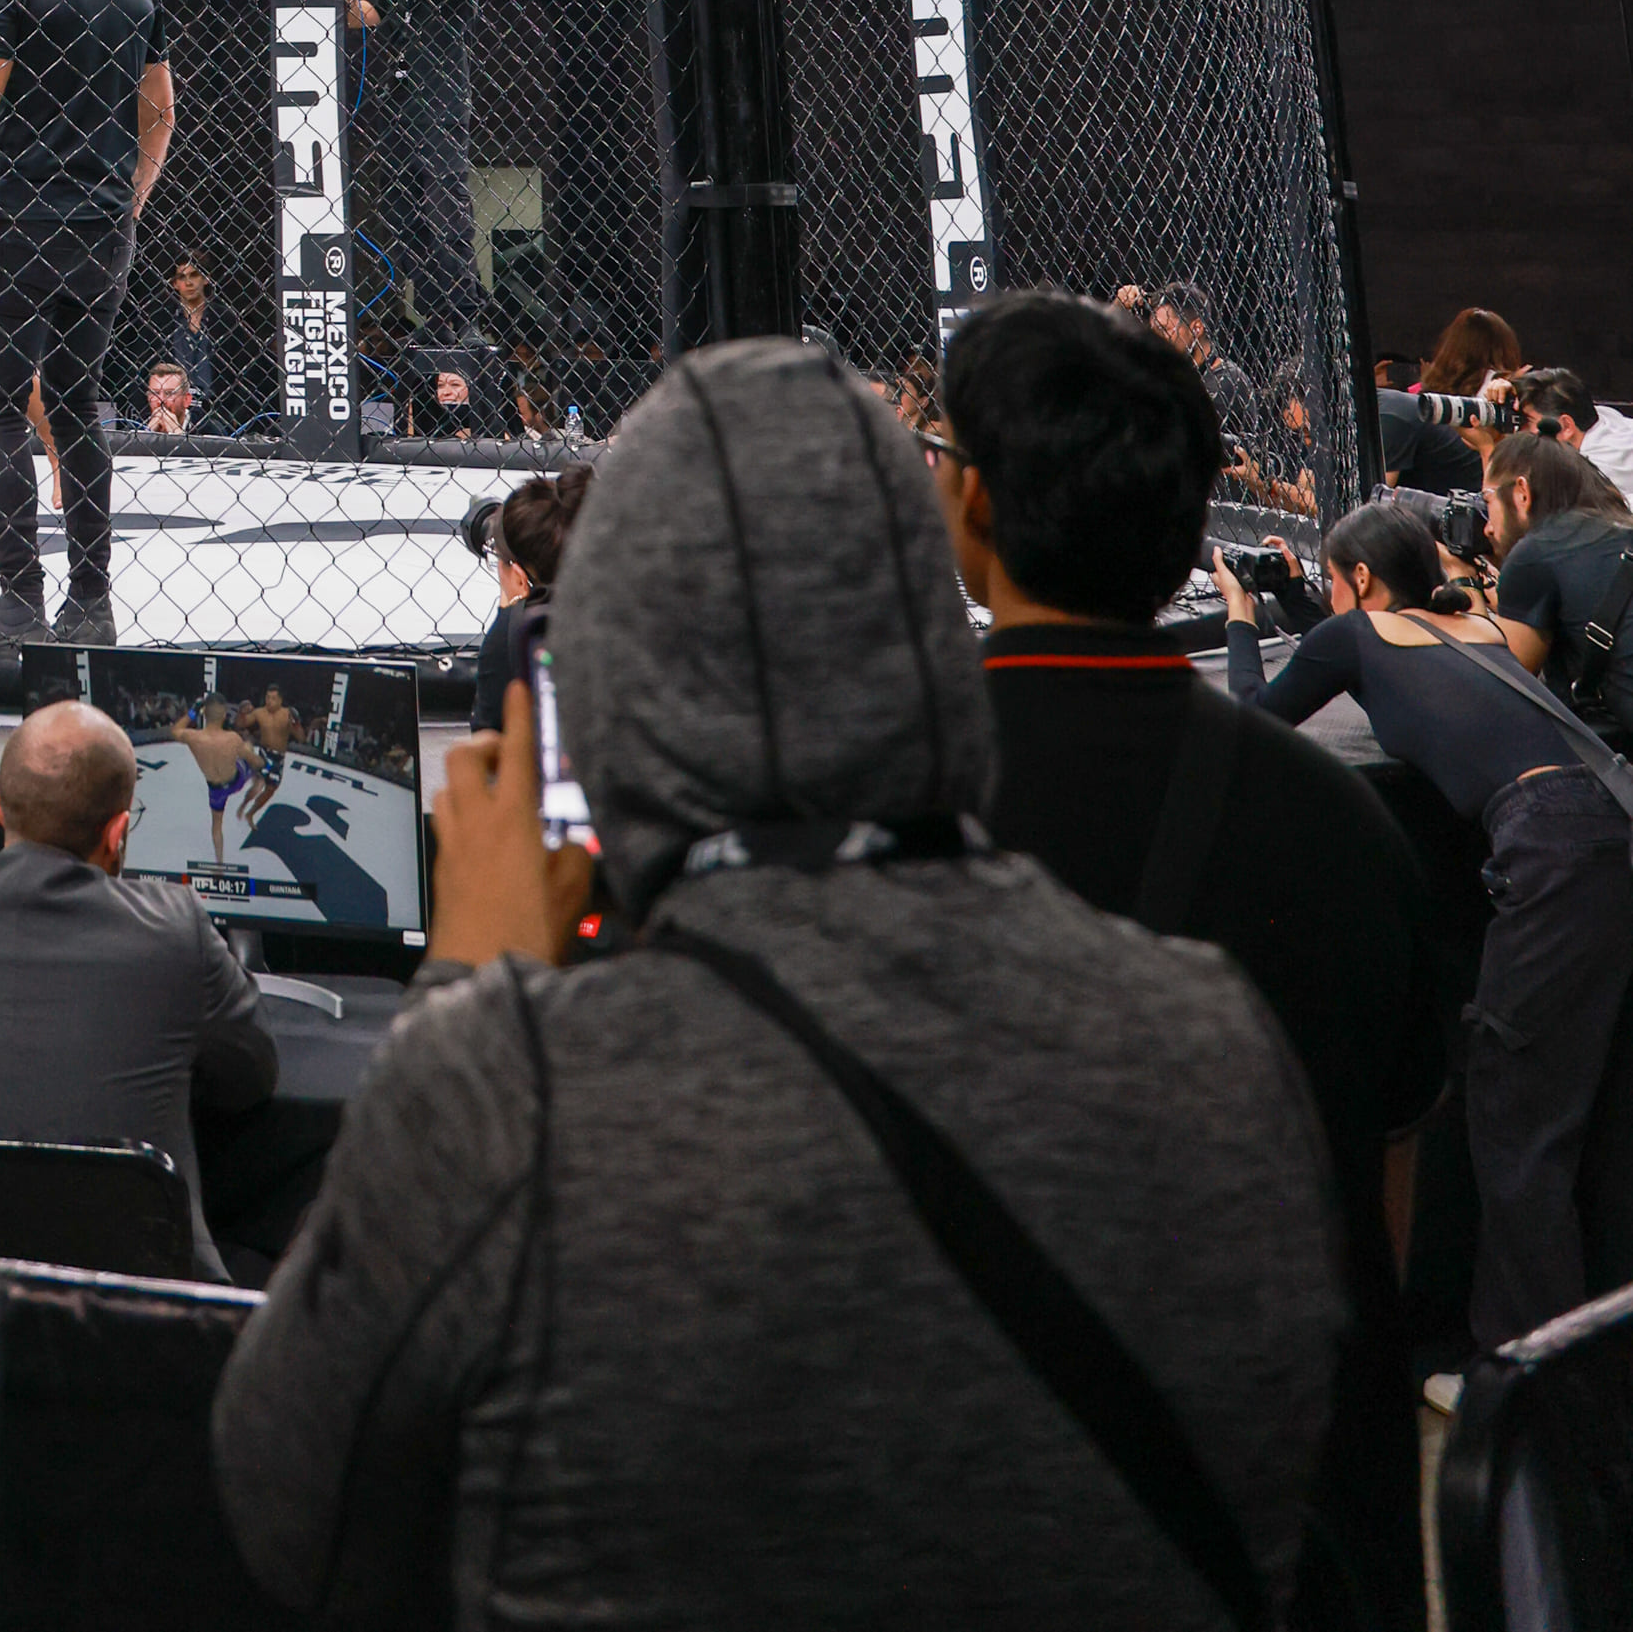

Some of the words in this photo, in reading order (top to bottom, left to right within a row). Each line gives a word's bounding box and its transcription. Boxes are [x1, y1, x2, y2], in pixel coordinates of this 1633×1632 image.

[274, 6, 346, 277] MFL
[282, 290, 308, 418] LEAGUE
[303, 290, 327, 385] FIGHT
[324, 290, 351, 422] MEXICO
[218, 880, 247, 893] 04:17
